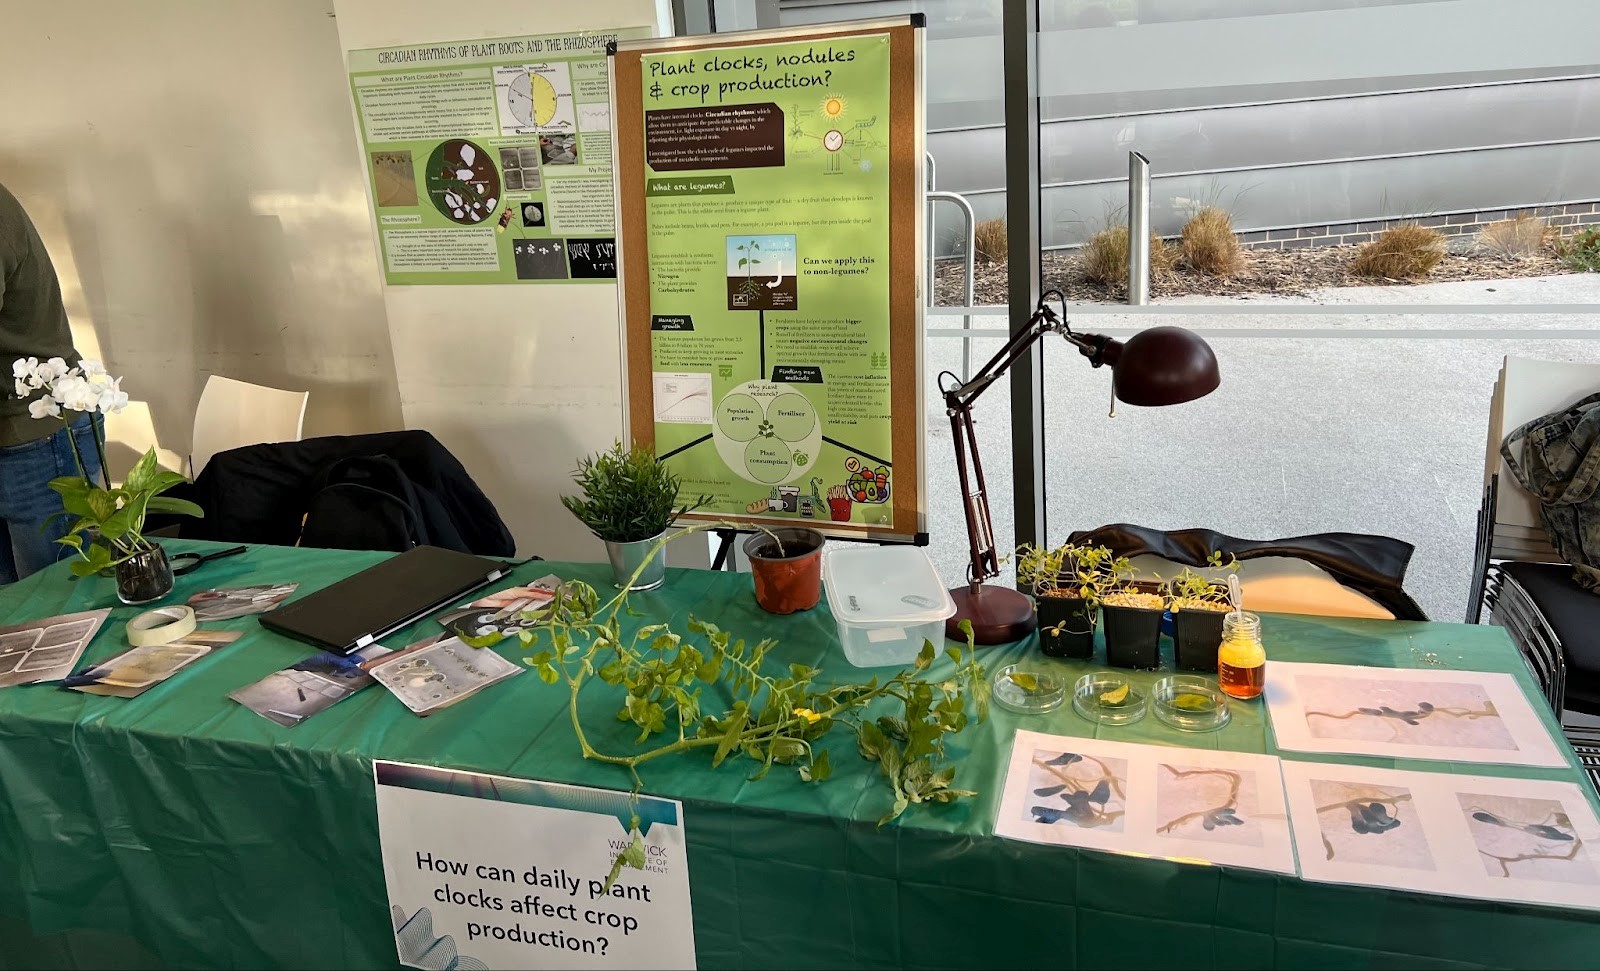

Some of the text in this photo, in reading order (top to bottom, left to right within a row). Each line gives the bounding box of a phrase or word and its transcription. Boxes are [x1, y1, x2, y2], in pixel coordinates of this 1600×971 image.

[378, 51, 417, 64] CIRCADIAN
[419, 46, 457, 61] RHYTHMS
[459, 46, 469, 58] OF
[472, 44, 496, 57] PLANT
[498, 41, 524, 55] ROOTS
[528, 40, 543, 53] AND
[545, 38, 561, 52] THE
[650, 47, 855, 77] Plant clocks, nodules
[650, 70, 832, 104] & crop production?
[652, 183, 671, 192] What
[690, 180, 726, 192] legumes?
[814, 267, 869, 277] non-legumes?
[834, 256, 857, 266] apply
[860, 256, 875, 264] this
[750, 458, 788, 466] consumption
[608, 838, 667, 858] WARICK
[416, 851, 651, 904] How can daily plant
[434, 884, 639, 936] clocks affect crop
[467, 921, 610, 956] production?
